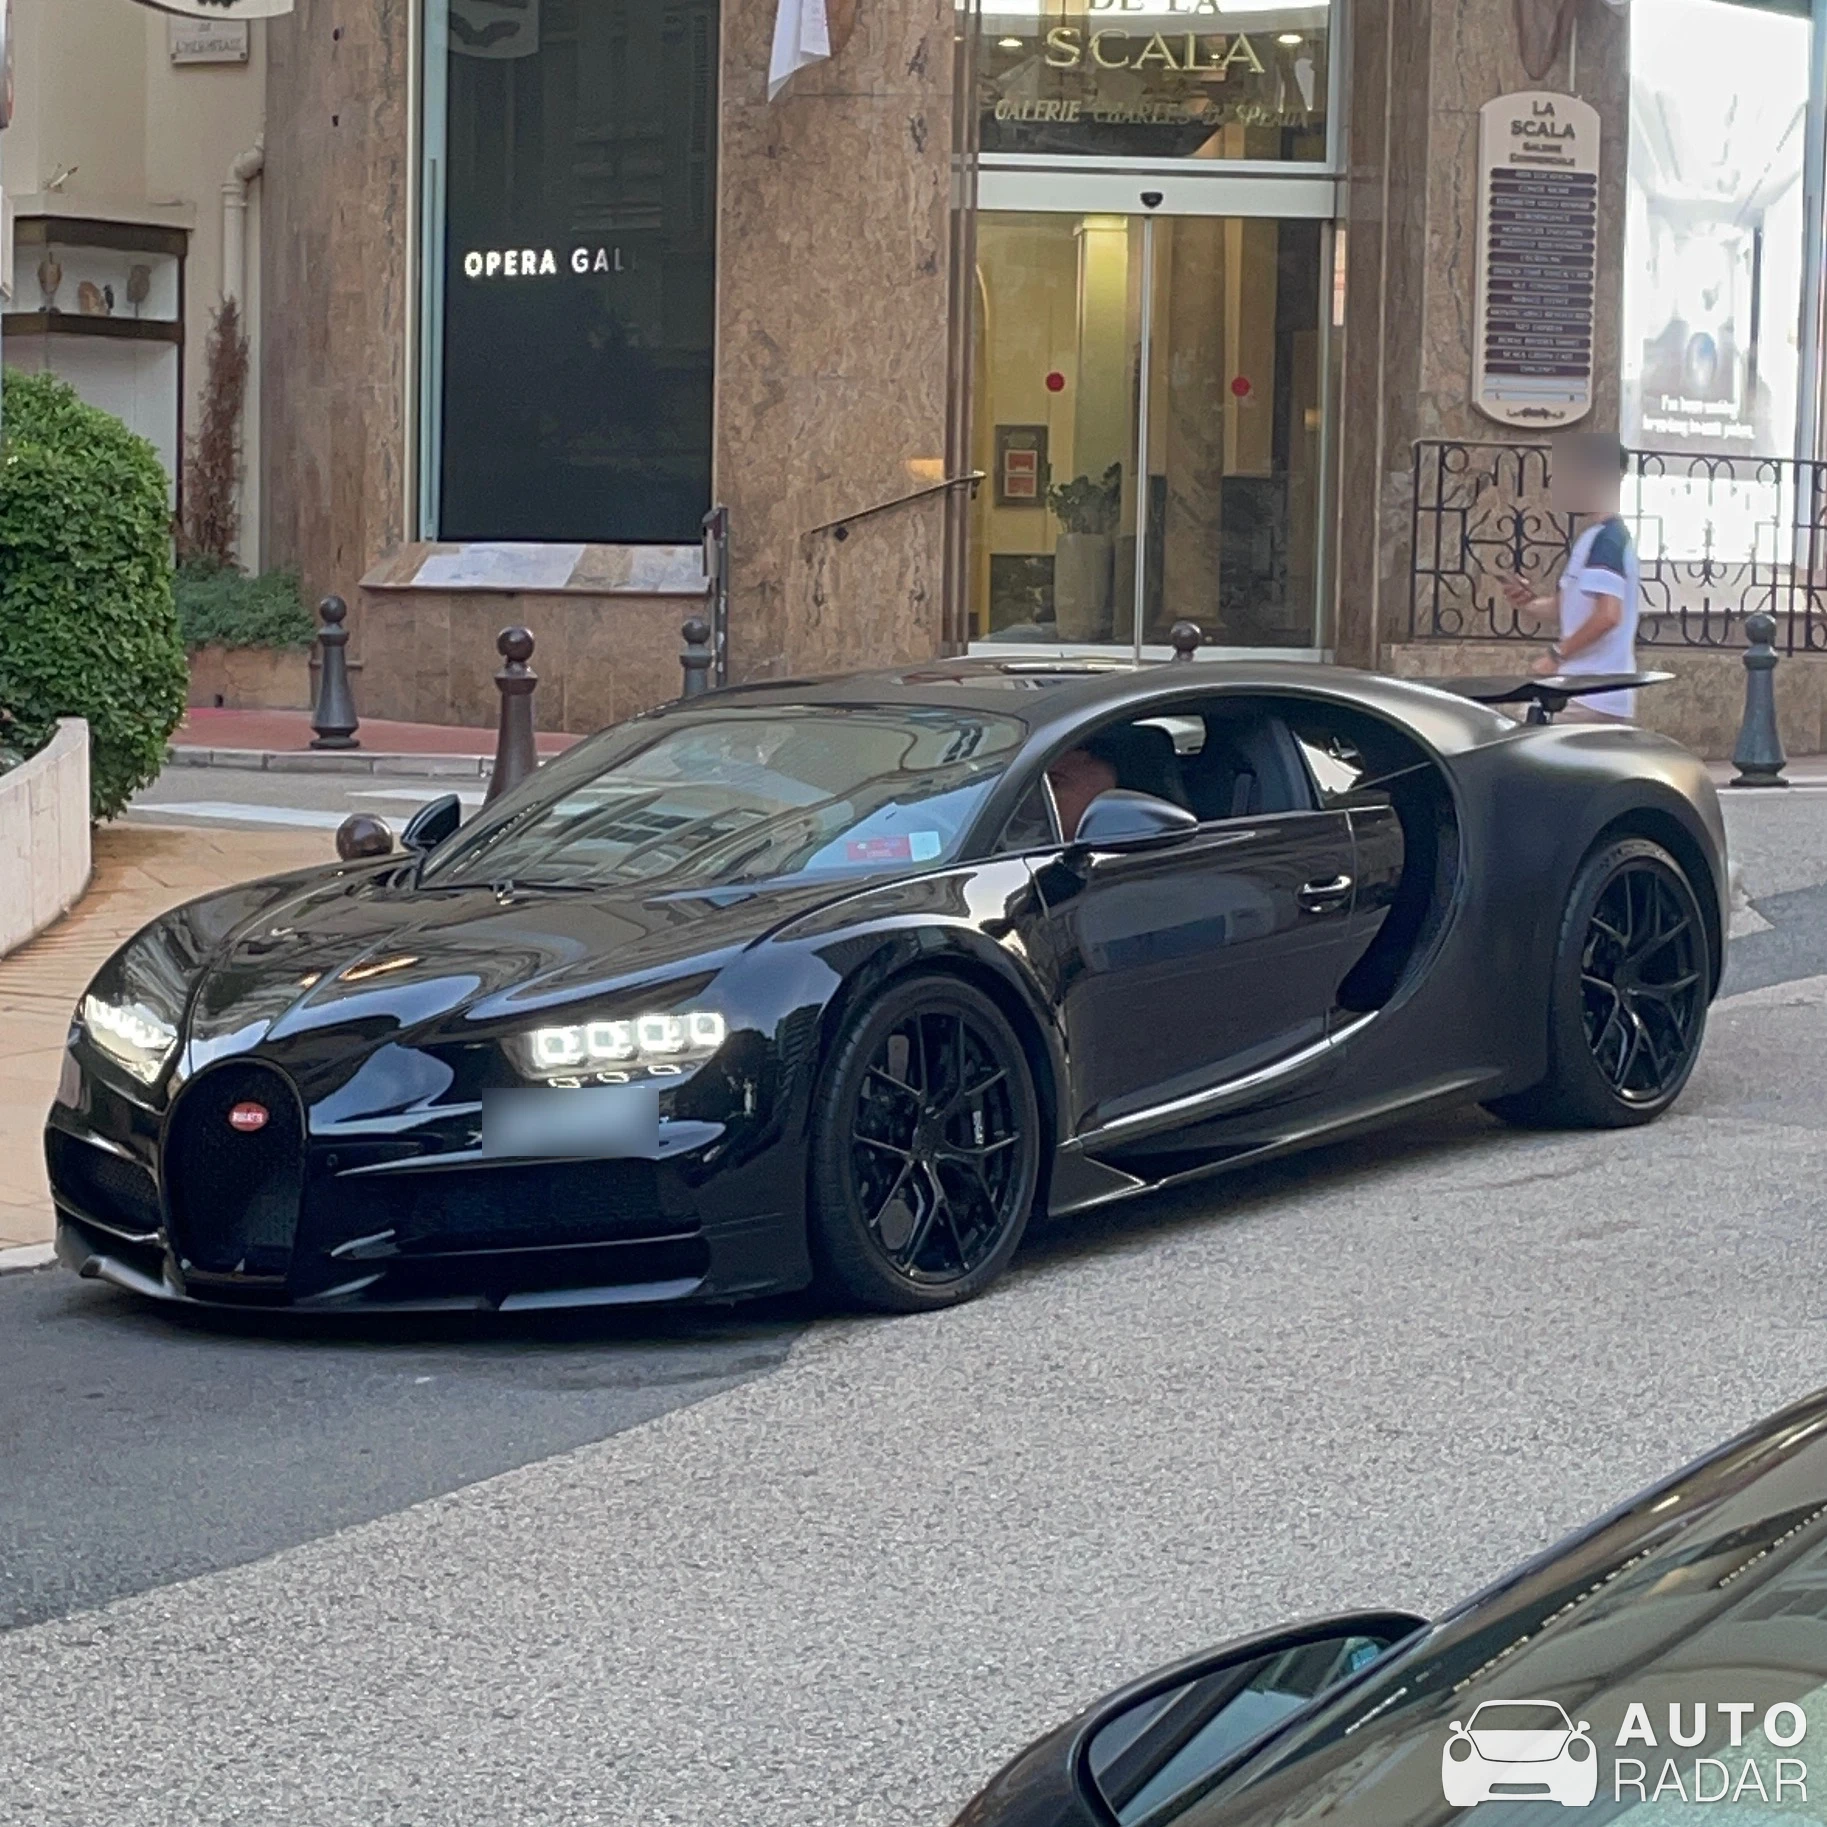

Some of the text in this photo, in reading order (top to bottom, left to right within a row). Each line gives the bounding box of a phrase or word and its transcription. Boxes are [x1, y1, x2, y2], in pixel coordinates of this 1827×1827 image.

[1045, 27, 1265, 73] SCALA
[995, 99, 1082, 123] GALERIE
[1532, 100, 1555, 116] LA
[1510, 120, 1576, 140] SCALA
[464, 248, 557, 277] OPERA
